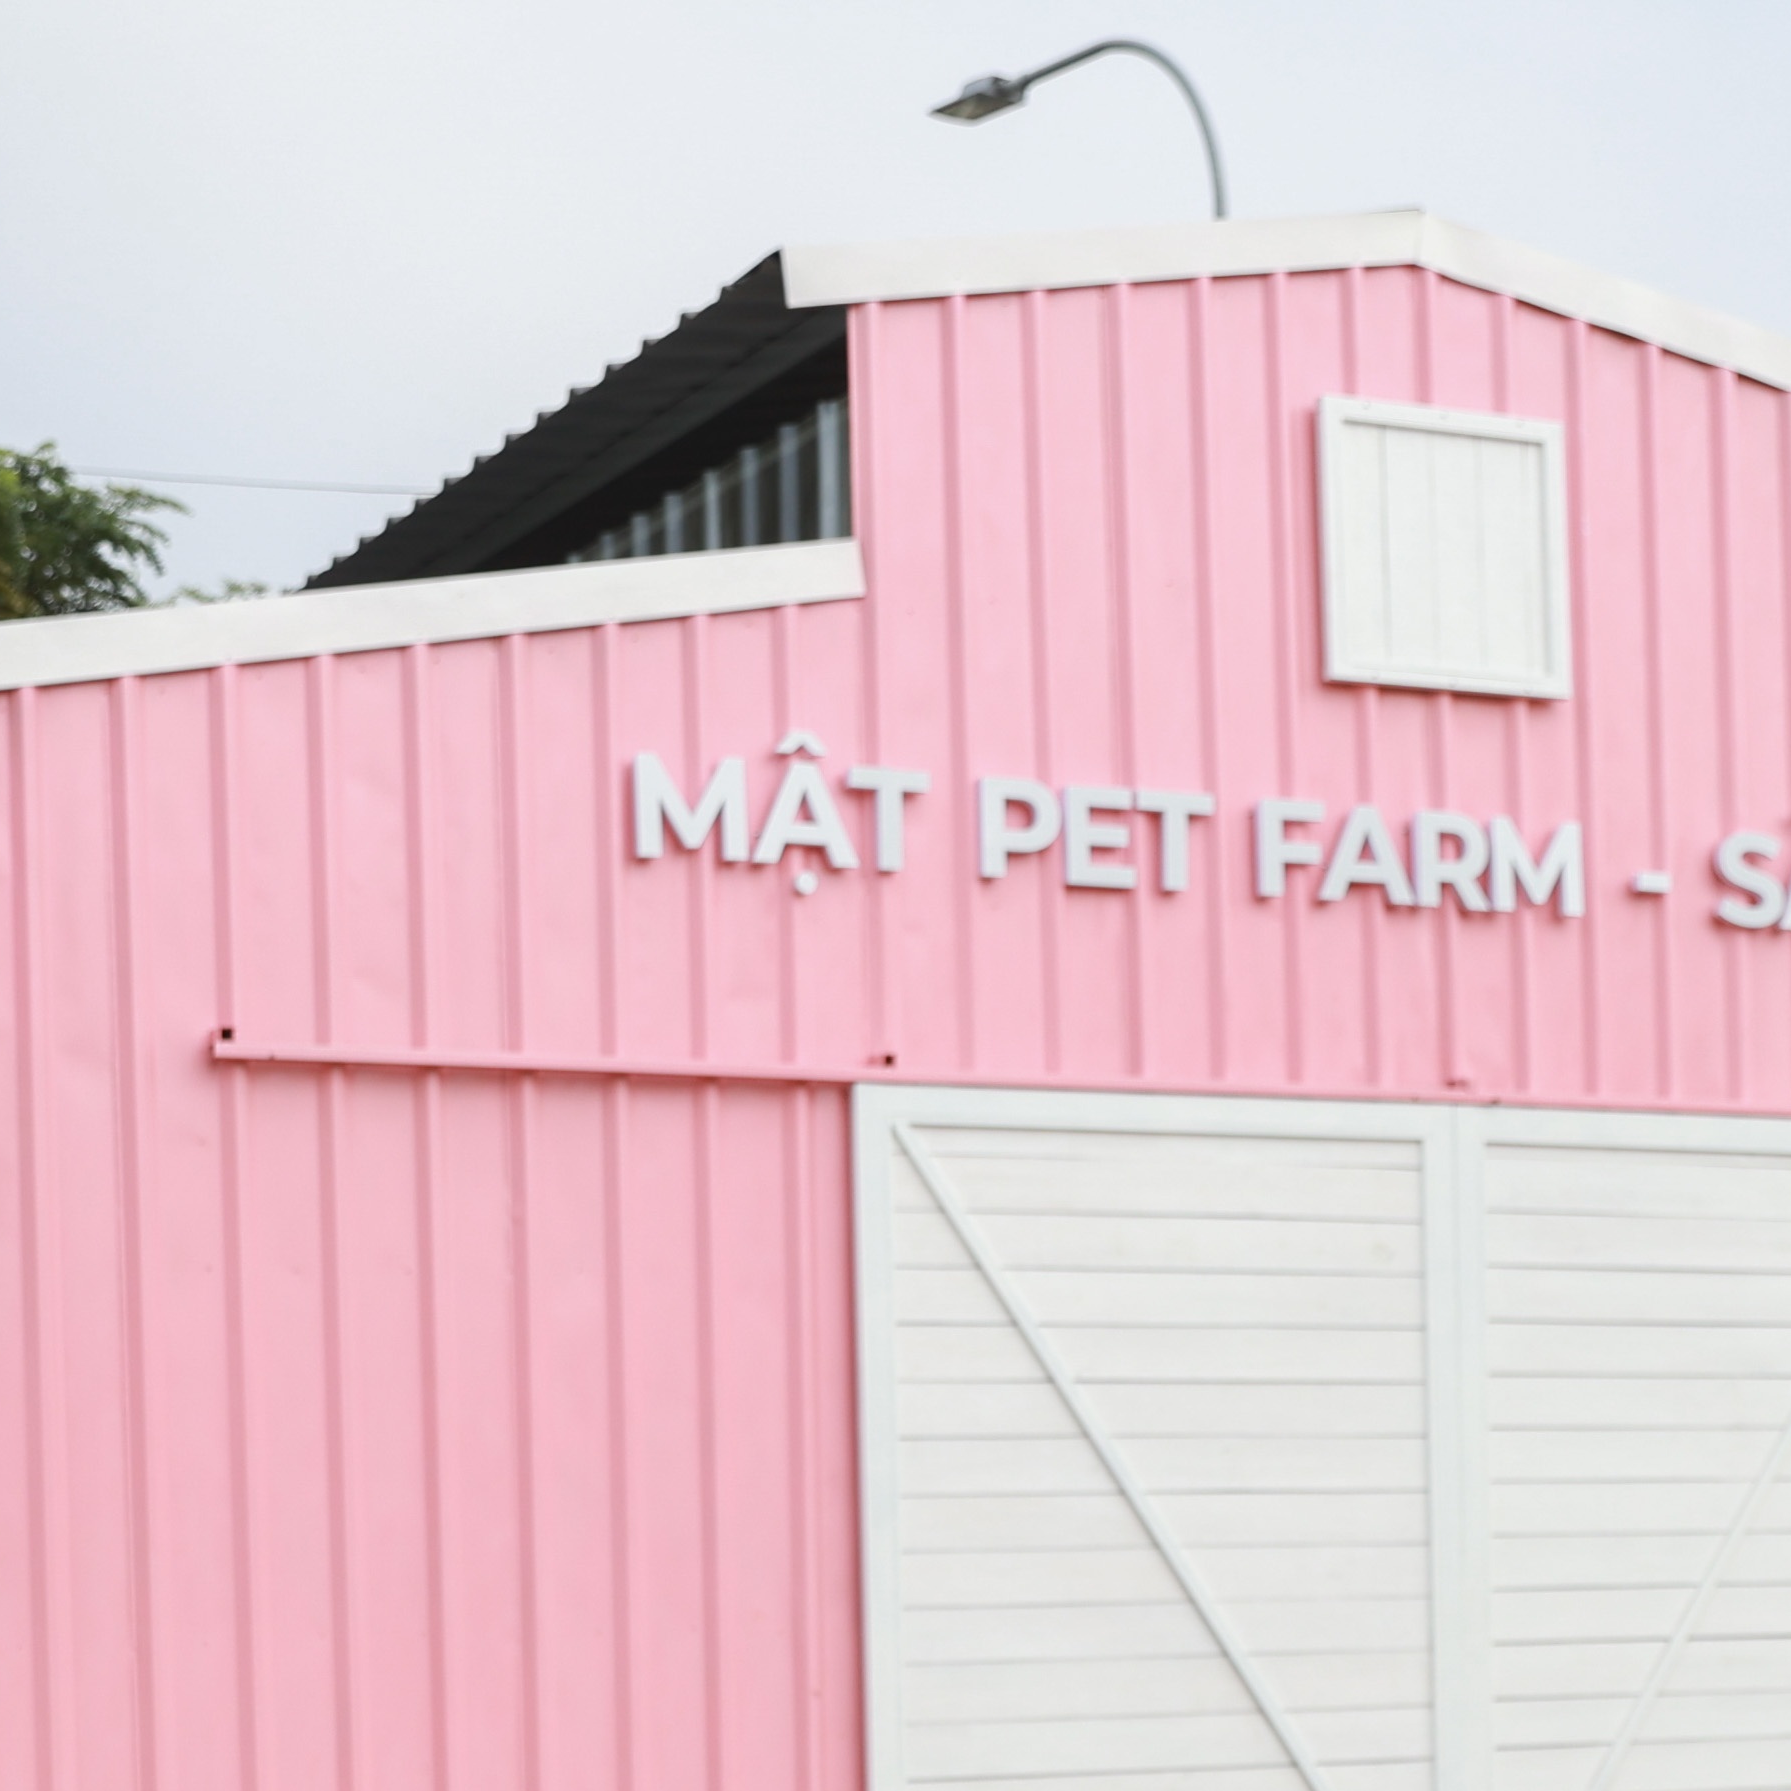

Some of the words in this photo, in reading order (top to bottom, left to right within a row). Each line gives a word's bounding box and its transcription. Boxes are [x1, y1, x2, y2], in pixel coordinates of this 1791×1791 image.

[632, 729, 932, 896] MẬT
[978, 775, 1216, 893] PET
[1256, 798, 1587, 919] FARM
[1631, 871, 1672, 895] -
